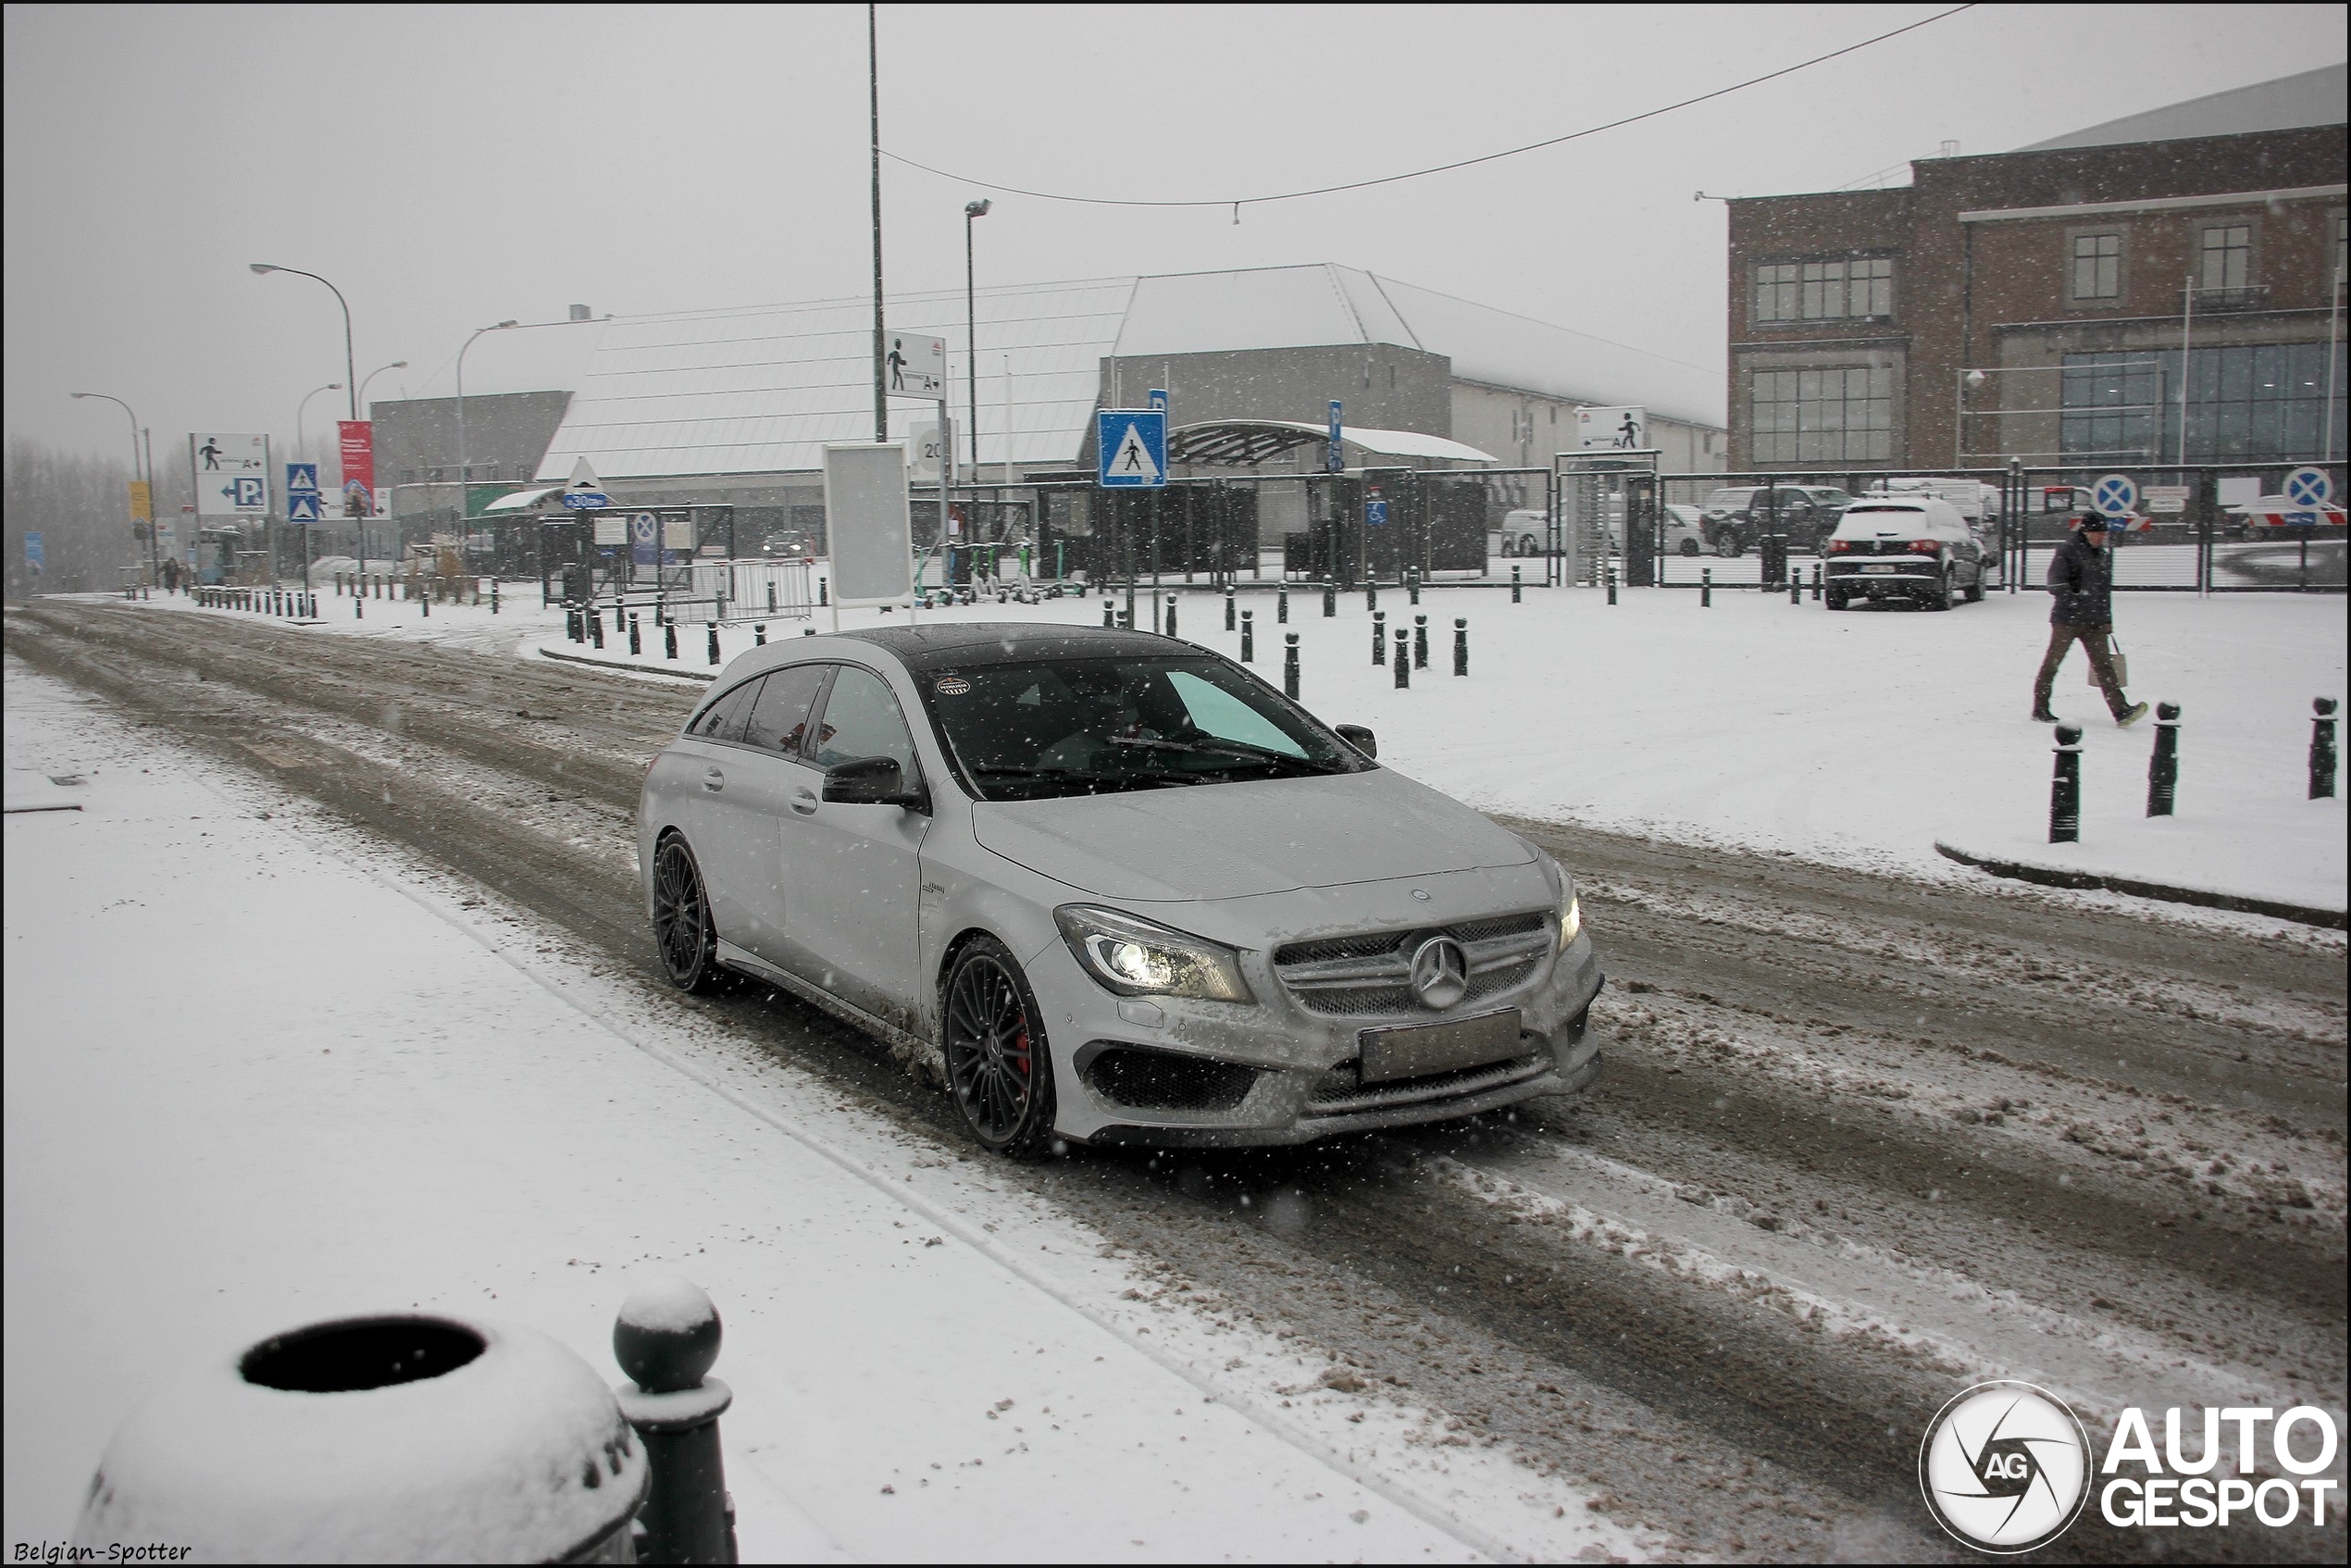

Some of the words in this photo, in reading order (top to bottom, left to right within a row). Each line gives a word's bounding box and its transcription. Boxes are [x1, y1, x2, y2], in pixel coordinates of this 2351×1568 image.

[924, 376, 932, 391] A
[1612, 438, 1622, 447] A
[243, 459, 252, 468] A
[240, 479, 260, 504] P
